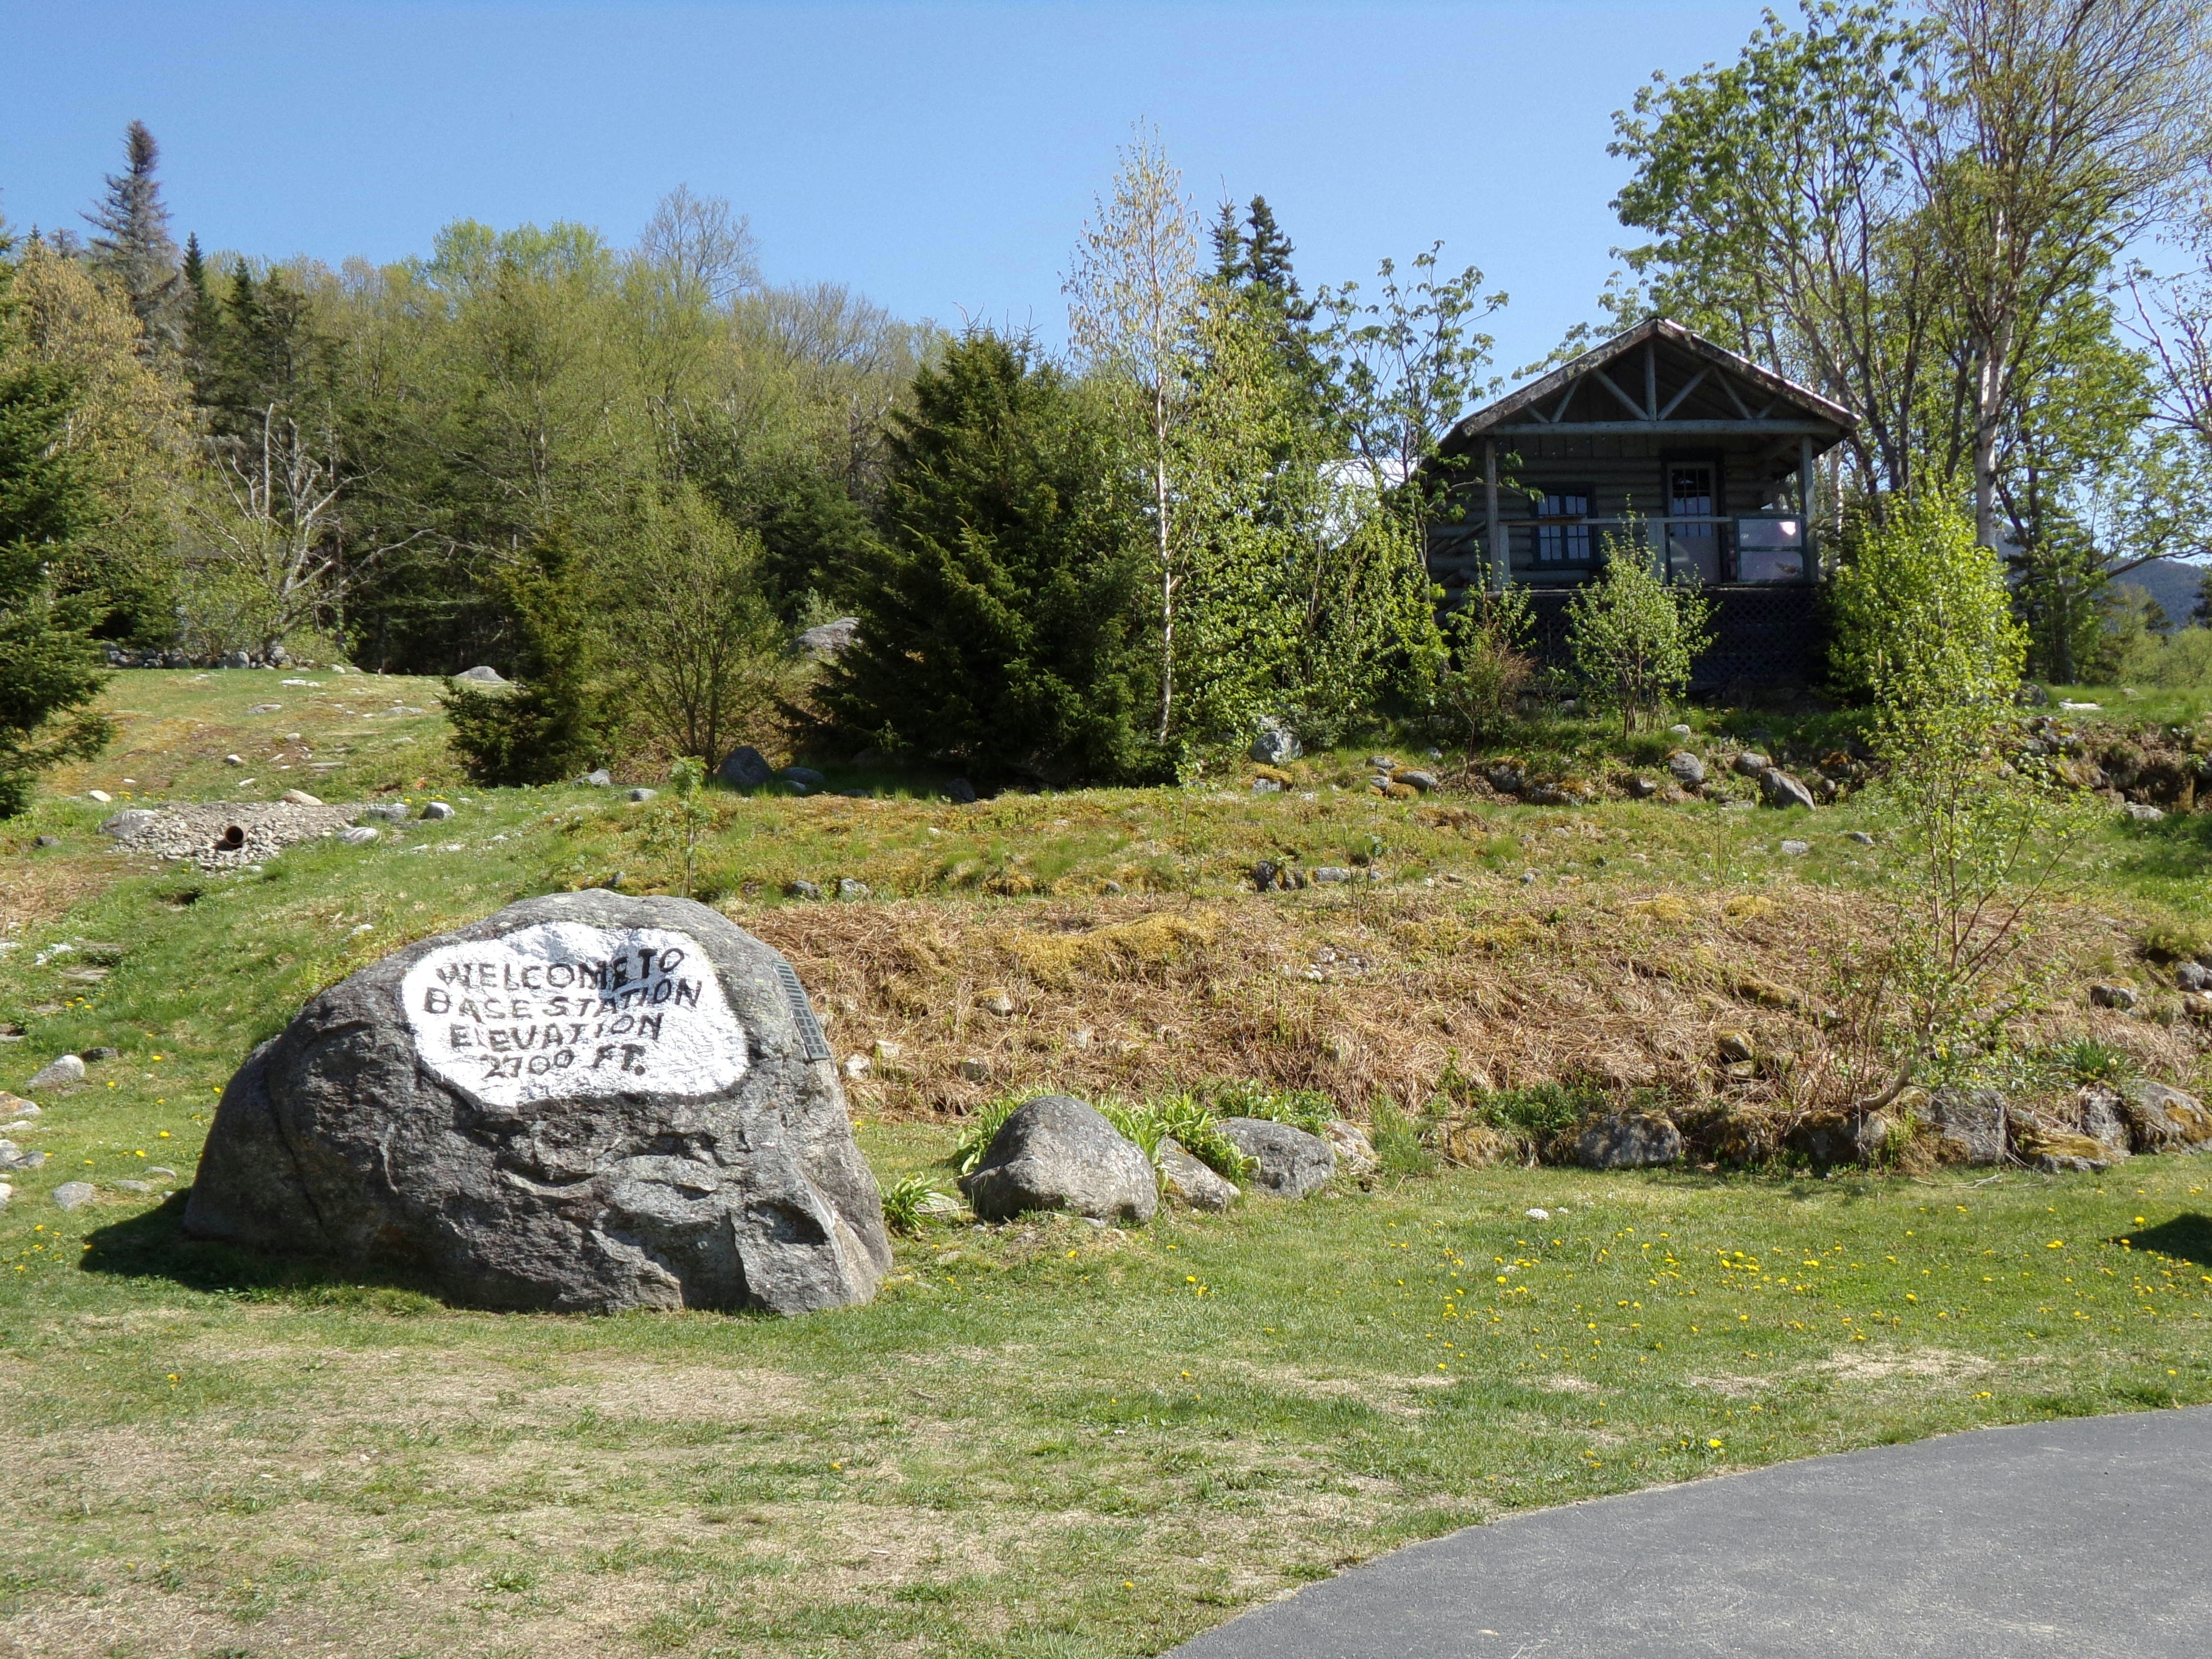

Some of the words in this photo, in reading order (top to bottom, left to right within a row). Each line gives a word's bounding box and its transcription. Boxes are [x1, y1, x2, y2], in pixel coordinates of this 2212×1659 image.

[436, 956, 633, 992] WELCOME
[638, 948, 685, 980] TO
[424, 986, 533, 1023] BASE
[541, 978, 702, 1020] STATION
[449, 1012, 664, 1052] ELEVATION
[480, 1049, 575, 1079] 2700
[591, 1043, 646, 1076] FT.
